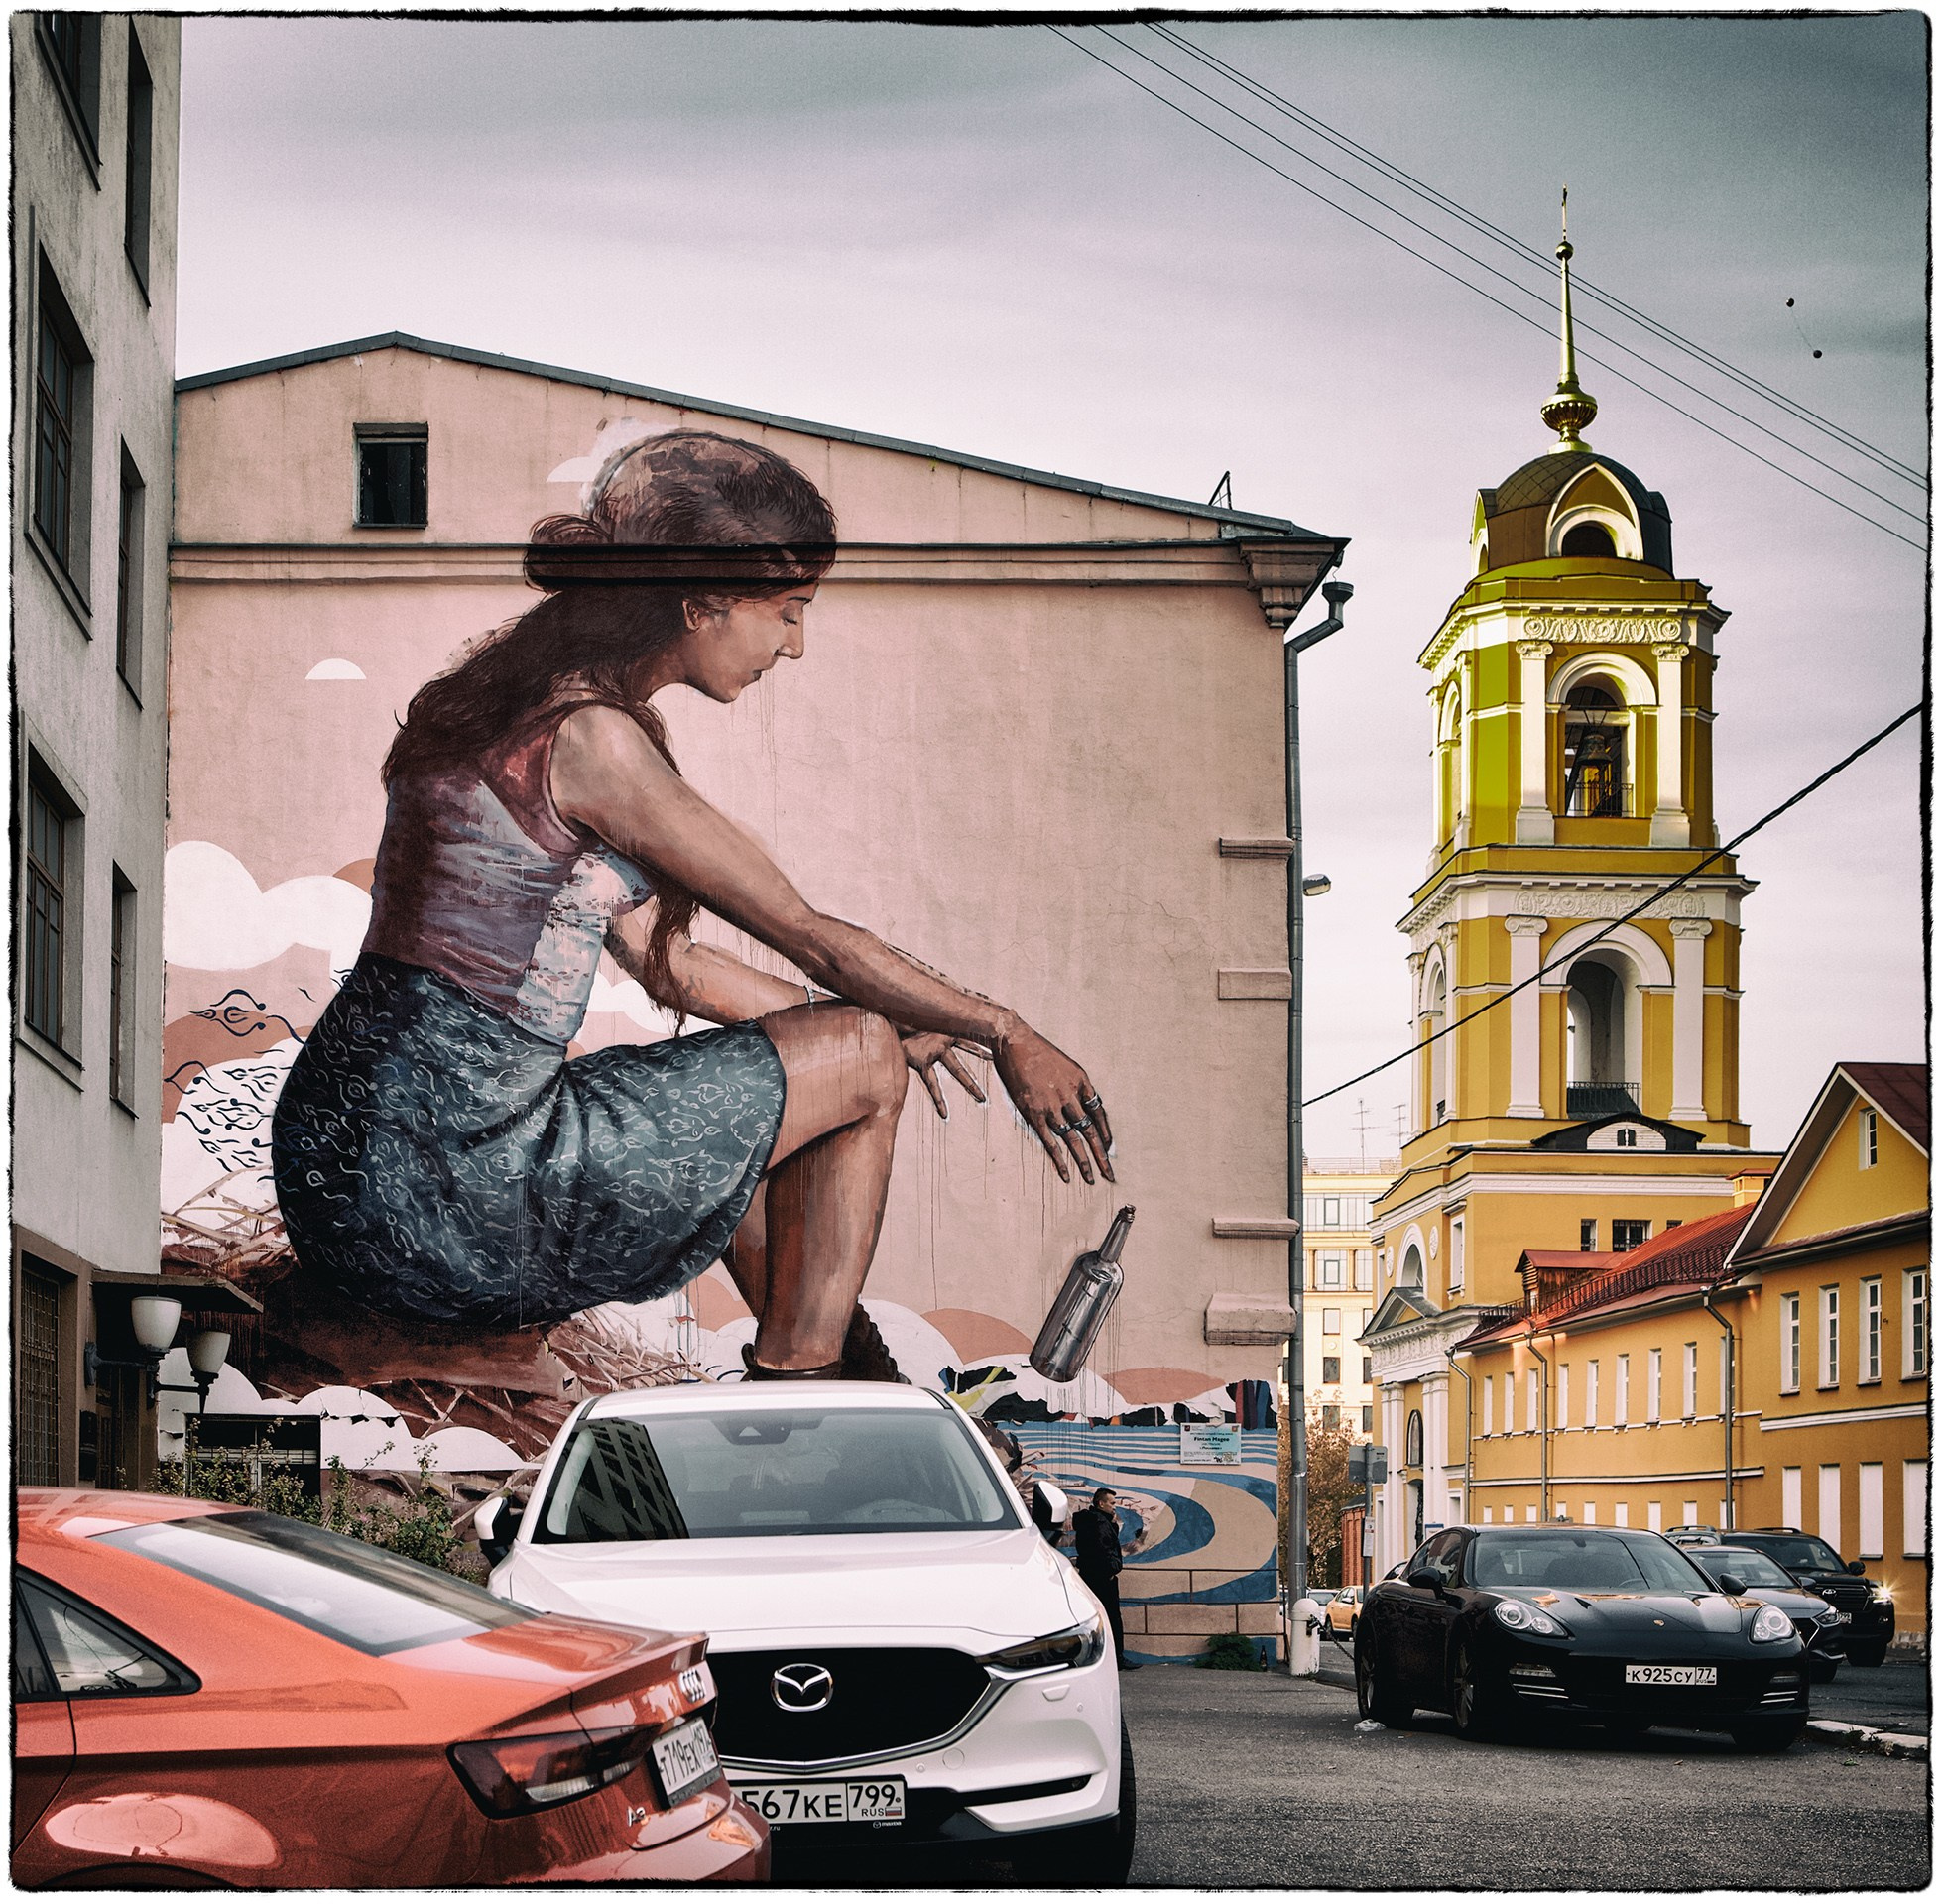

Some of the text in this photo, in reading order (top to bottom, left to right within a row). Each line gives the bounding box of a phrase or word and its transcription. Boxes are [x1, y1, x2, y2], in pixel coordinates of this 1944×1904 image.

[1697, 1668, 1712, 1680] 77
[742, 1789, 843, 1820] 567KE
[849, 1784, 897, 1809] 799
[861, 1807, 885, 1817] RUS
